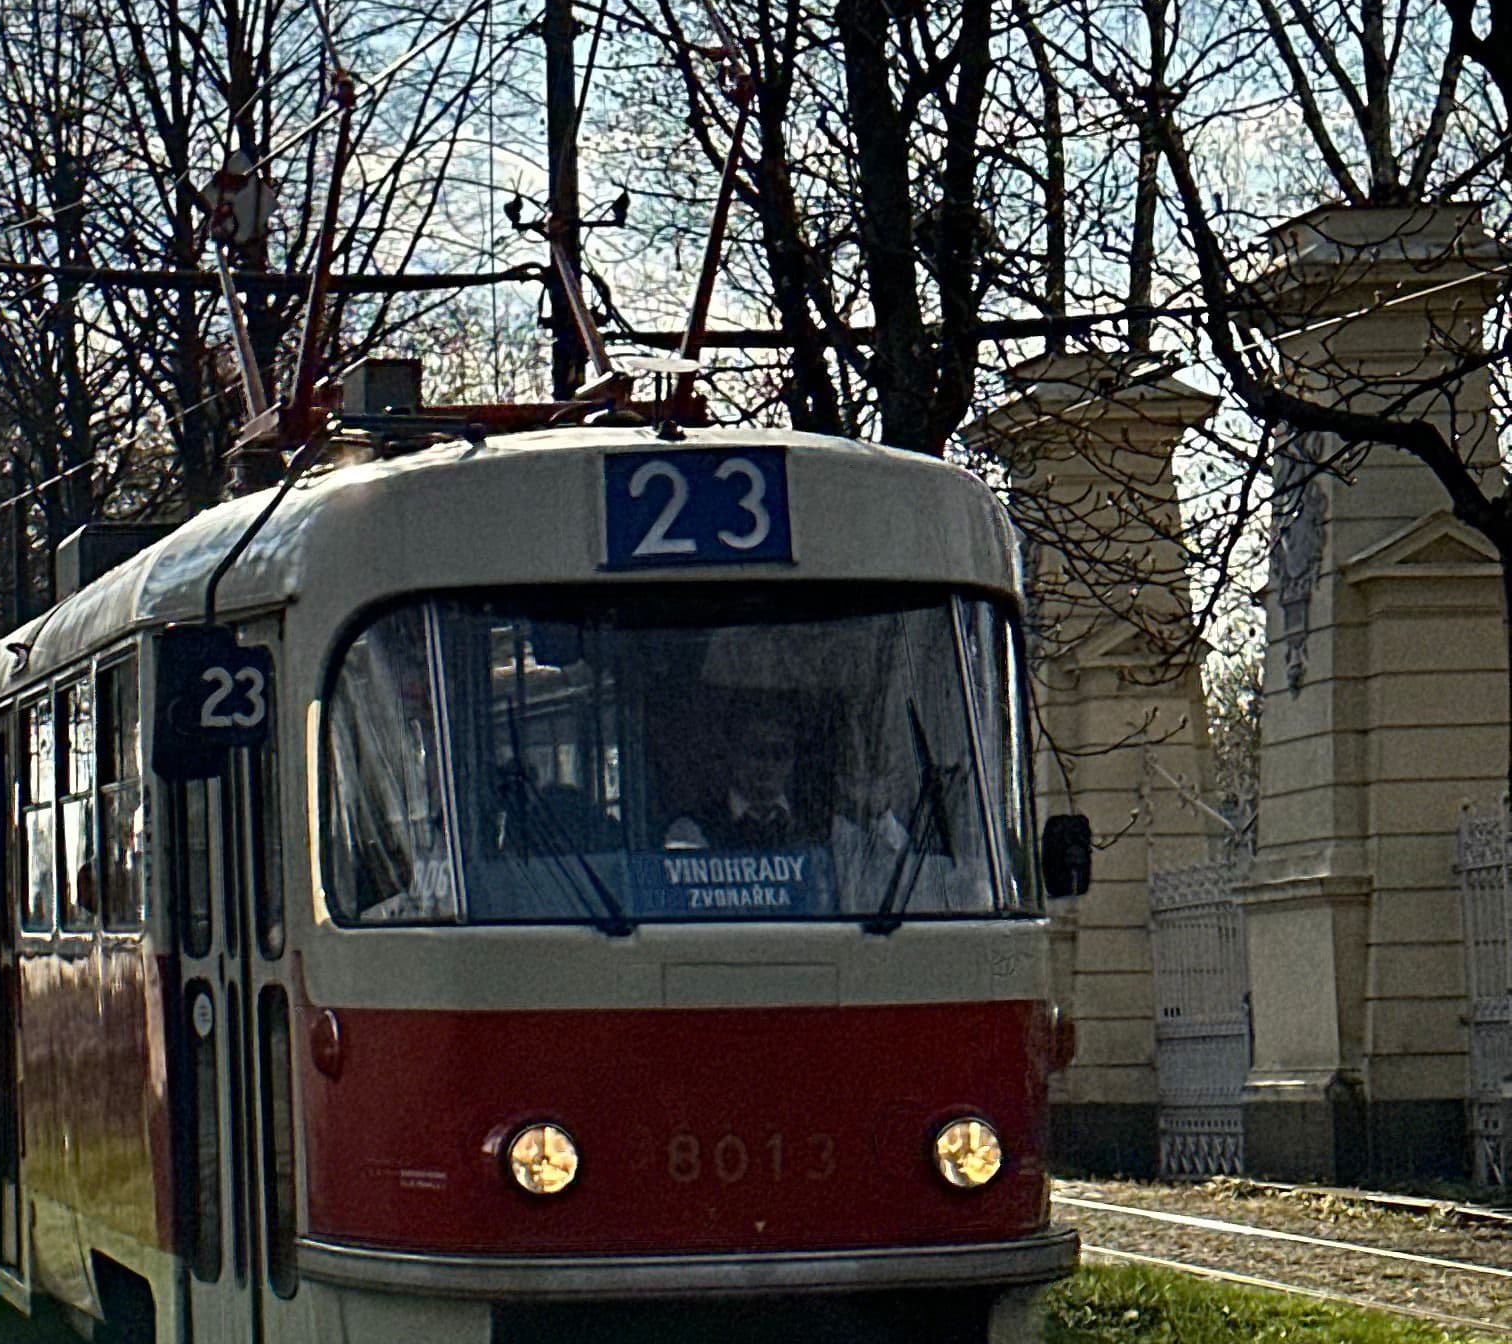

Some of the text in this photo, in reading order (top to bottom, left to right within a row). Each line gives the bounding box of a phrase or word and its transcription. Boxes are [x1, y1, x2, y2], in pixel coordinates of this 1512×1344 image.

[629, 458, 771, 555] 23
[200, 666, 265, 727] 23
[664, 856, 805, 884] VINOHRADY
[689, 884, 791, 908] ZVONAŘKA
[667, 1132, 837, 1184] 8013
